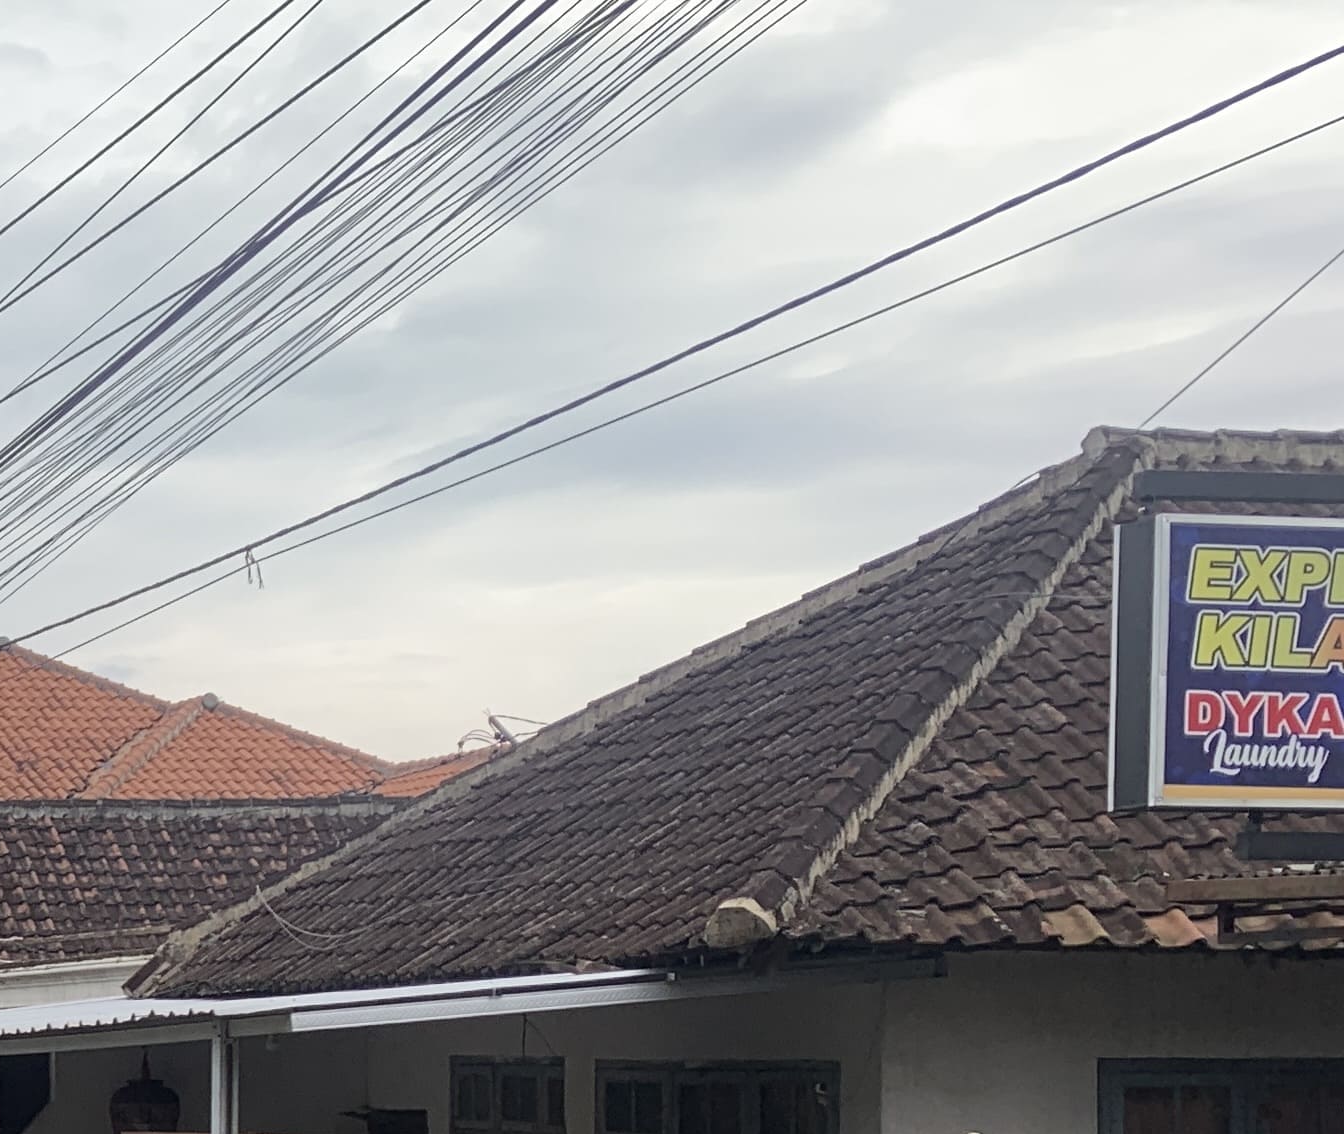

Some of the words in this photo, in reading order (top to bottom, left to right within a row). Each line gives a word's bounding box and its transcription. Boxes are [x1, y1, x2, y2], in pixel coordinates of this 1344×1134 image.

[1186, 544, 1344, 607] EXP
[1185, 690, 1344, 738] DYKA
[1204, 728, 1329, 783] Laundry
